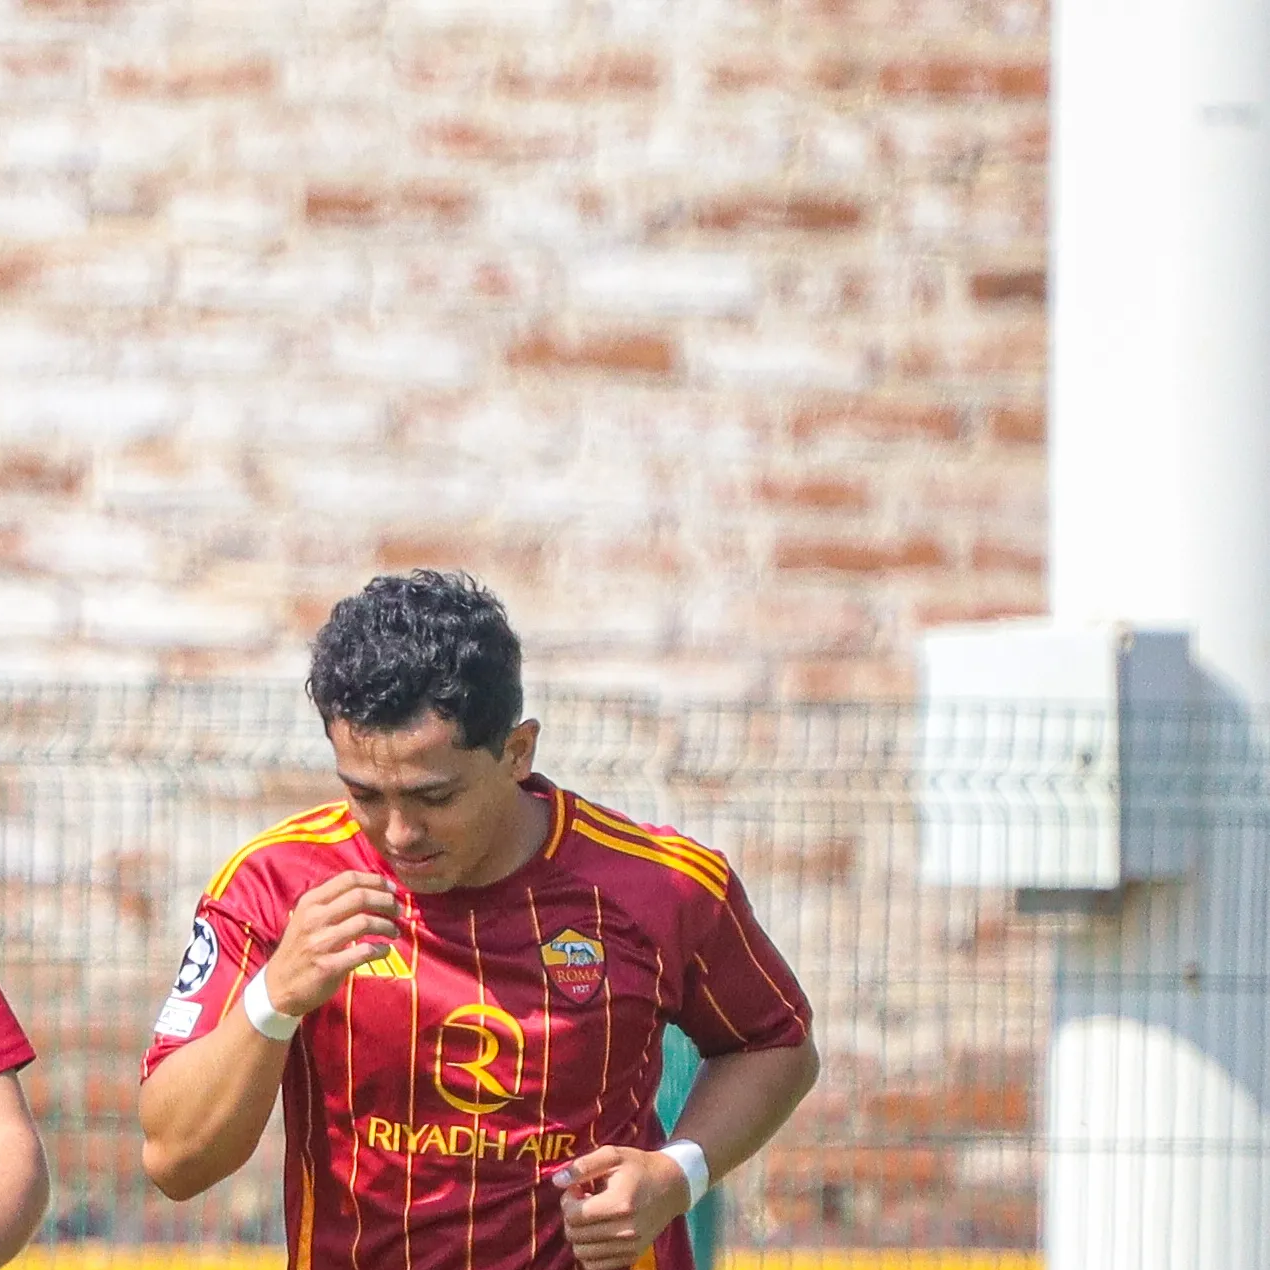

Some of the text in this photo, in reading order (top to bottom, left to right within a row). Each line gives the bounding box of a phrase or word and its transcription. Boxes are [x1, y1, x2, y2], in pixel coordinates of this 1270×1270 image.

[556, 968, 602, 983] ROMA
[368, 1116, 577, 1161] RIYADH AIR
